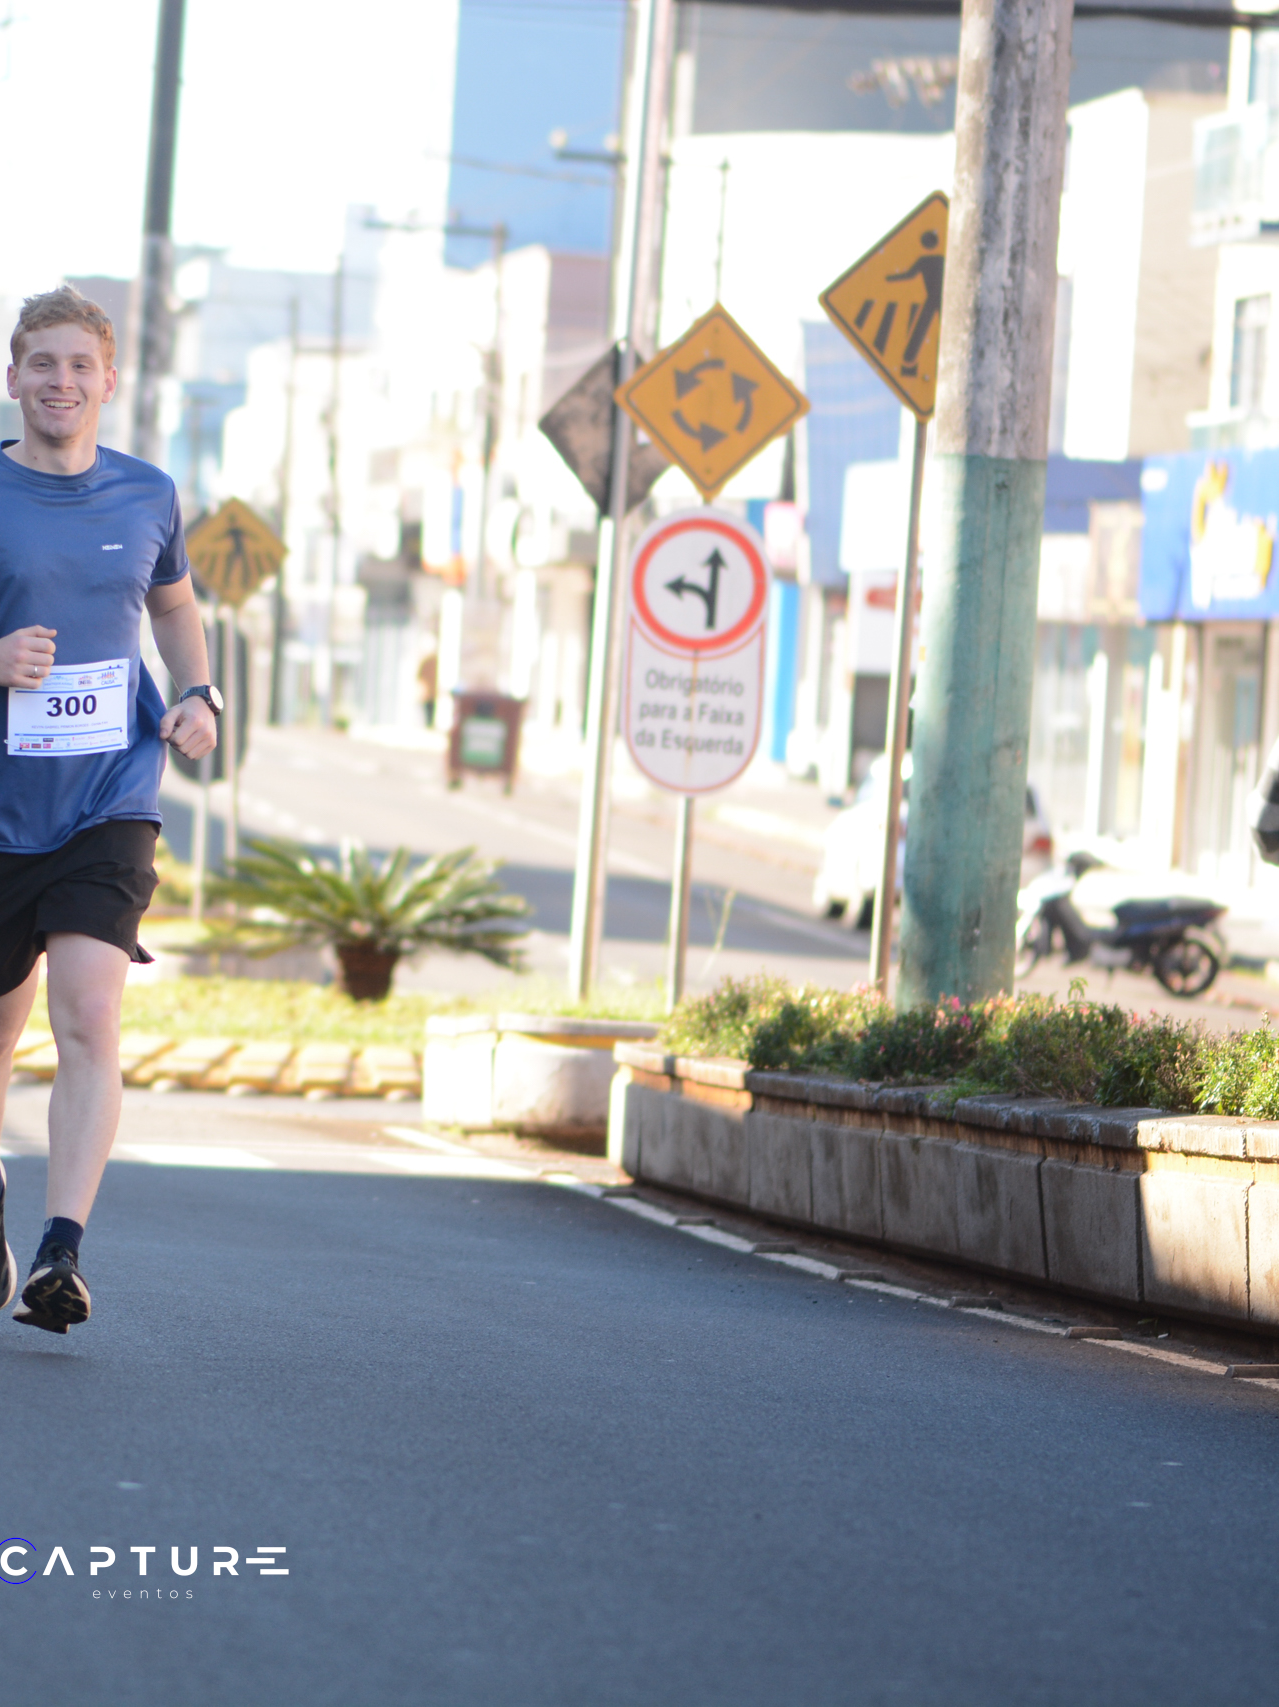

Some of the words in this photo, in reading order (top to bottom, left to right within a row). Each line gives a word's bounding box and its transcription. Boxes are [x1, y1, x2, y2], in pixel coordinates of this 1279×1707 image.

[645, 668, 744, 697] Obrigatório
[46, 694, 97, 717] 300
[639, 703, 677, 721] para
[683, 705, 692, 721] a
[698, 703, 744, 726] Faixa
[635, 728, 656, 747] da
[661, 728, 744, 756] Esquerda
